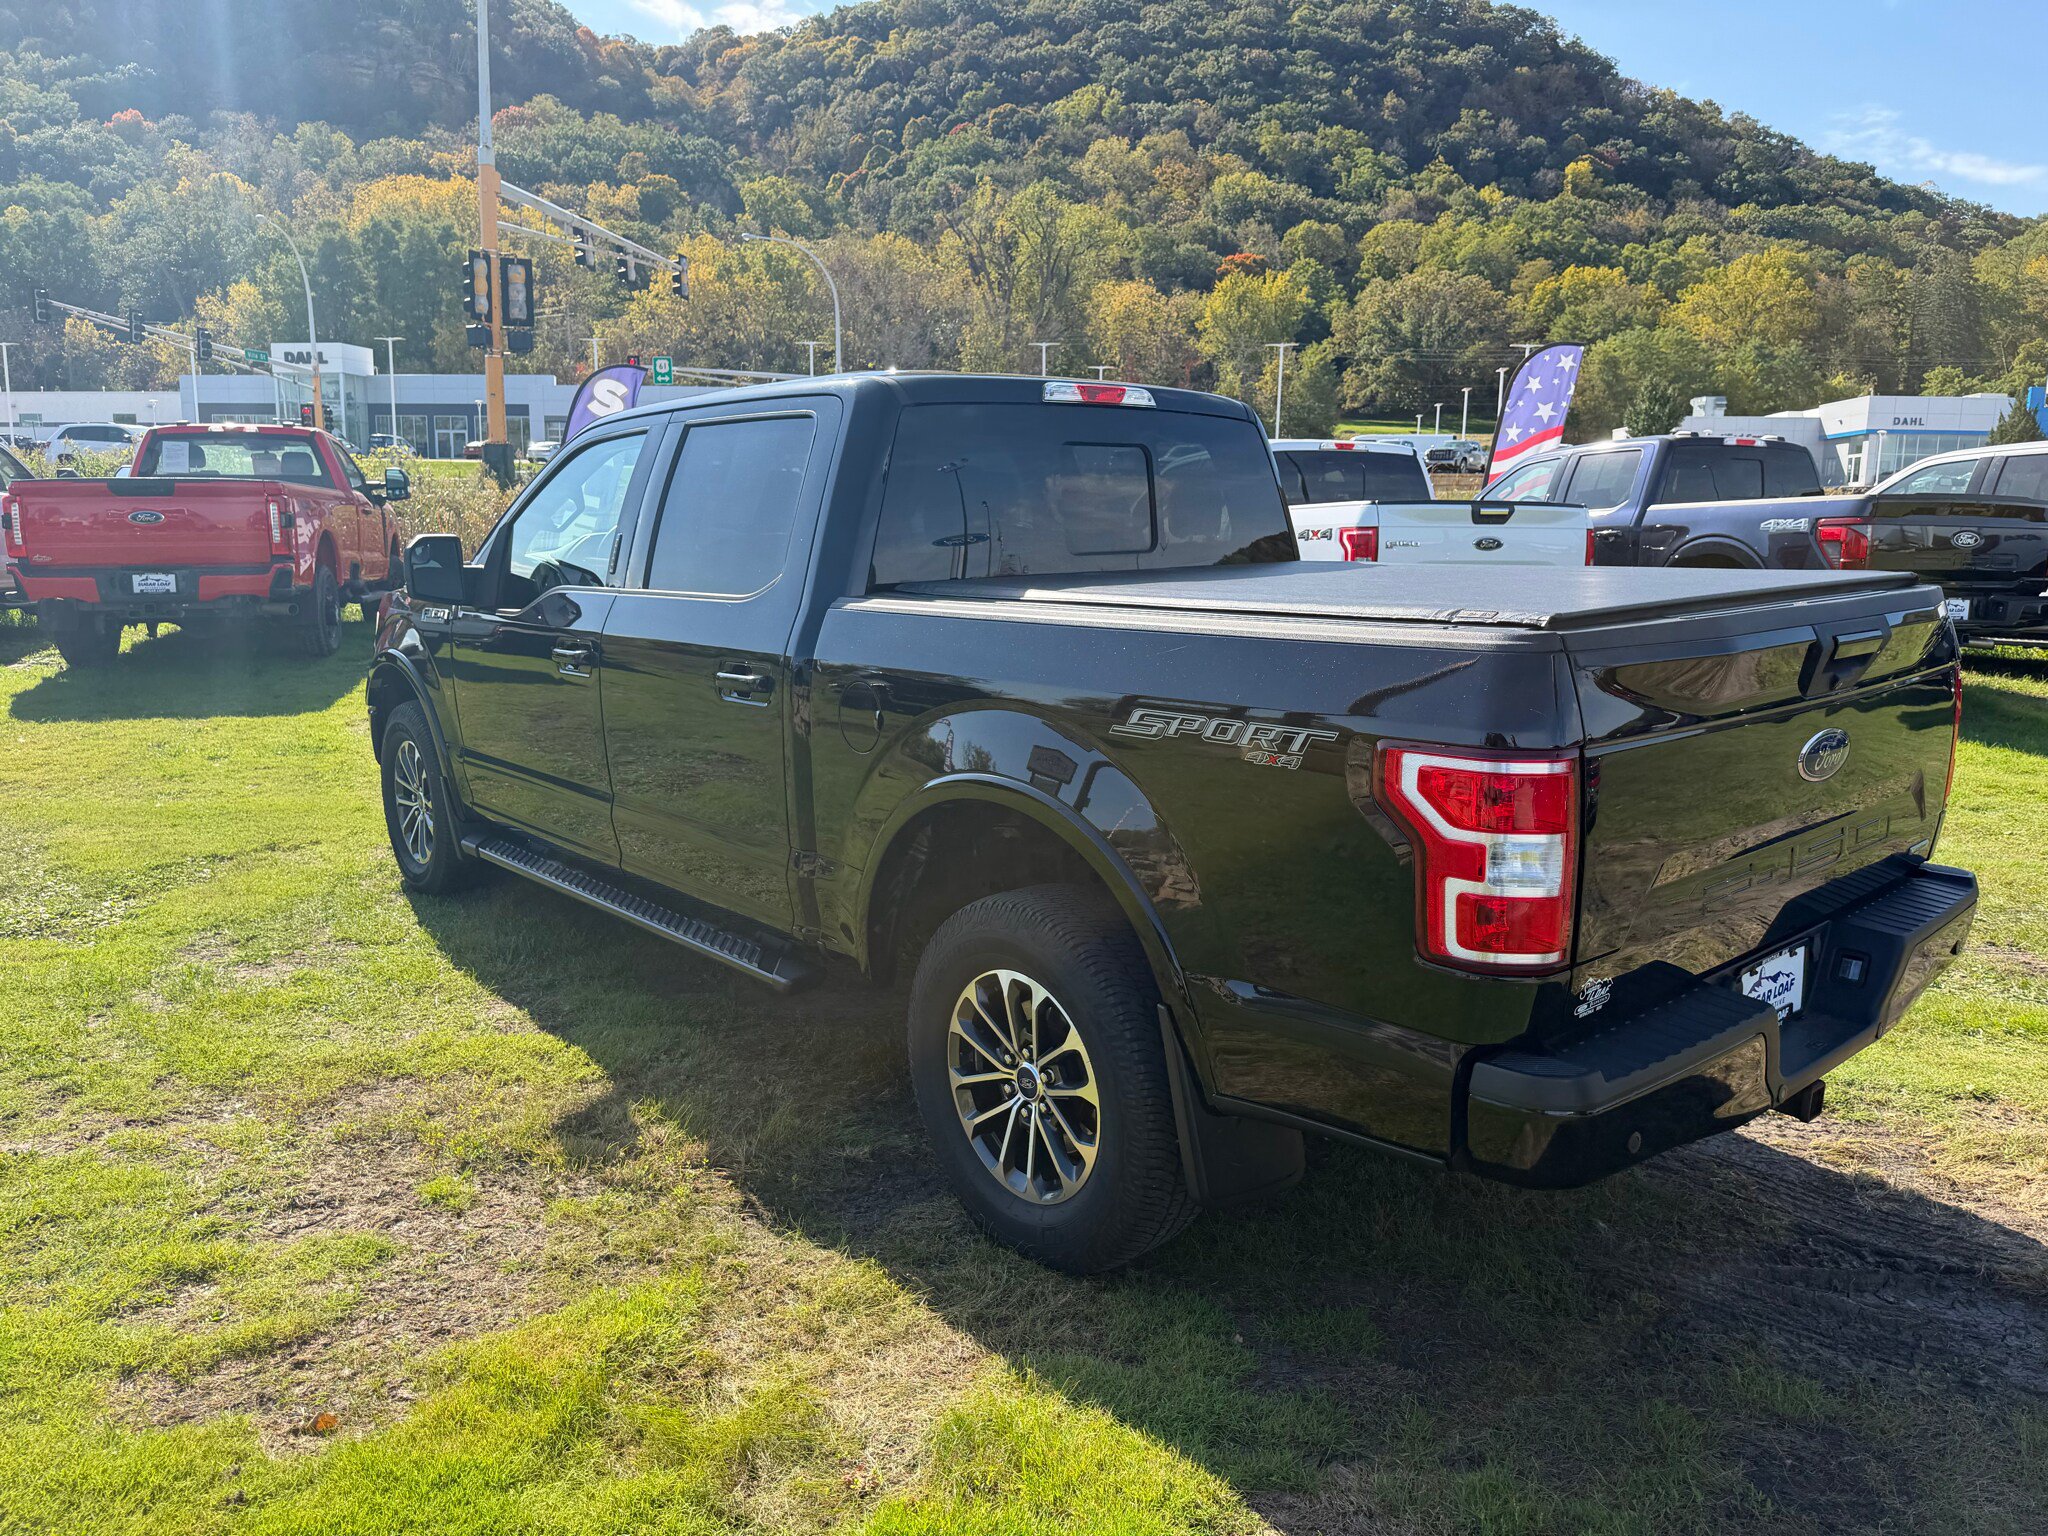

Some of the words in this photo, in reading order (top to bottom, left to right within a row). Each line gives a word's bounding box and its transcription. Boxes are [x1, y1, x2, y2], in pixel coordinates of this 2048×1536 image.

[587, 379, 629, 417] S
[1893, 417, 1925, 426] DAHL
[136, 513, 156, 522] Ford
[1298, 528, 1333, 541] 4x4
[1958, 533, 1976, 545] Ford
[1479, 539, 1498, 549] Ford
[1109, 708, 1339, 755] SPORT
[1245, 751, 1303, 770] 4x4
[1814, 740, 1844, 771] Ford
[1773, 977, 1796, 999] LOAF
[1778, 1006, 1790, 1019] OAF
